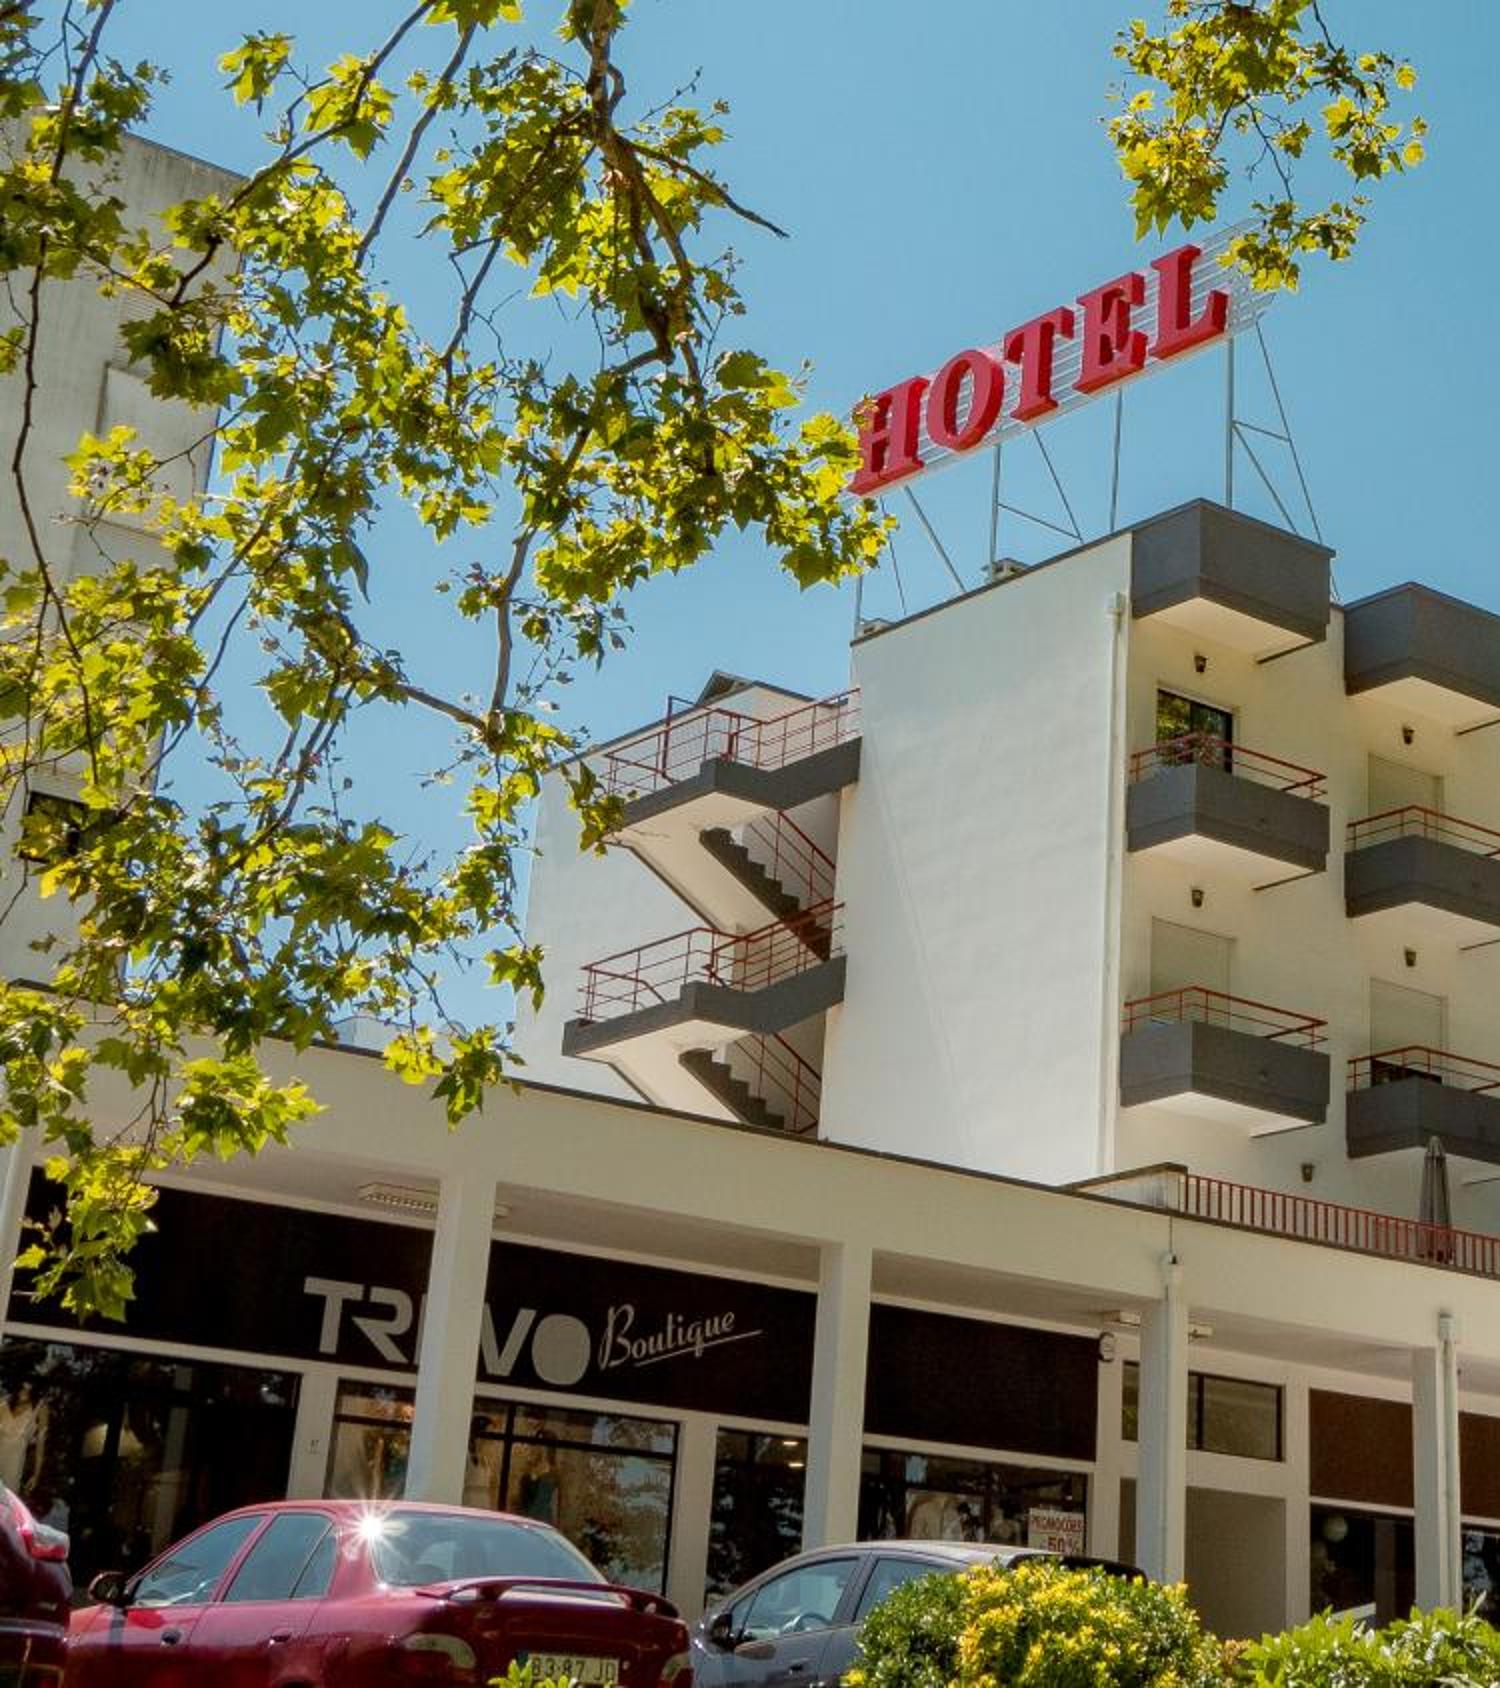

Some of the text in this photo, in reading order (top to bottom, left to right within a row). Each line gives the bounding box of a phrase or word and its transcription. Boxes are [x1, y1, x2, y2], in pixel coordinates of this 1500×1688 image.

[848, 244, 1229, 495] HOTEL
[303, 1276, 736, 1386] TRVO Boutique
